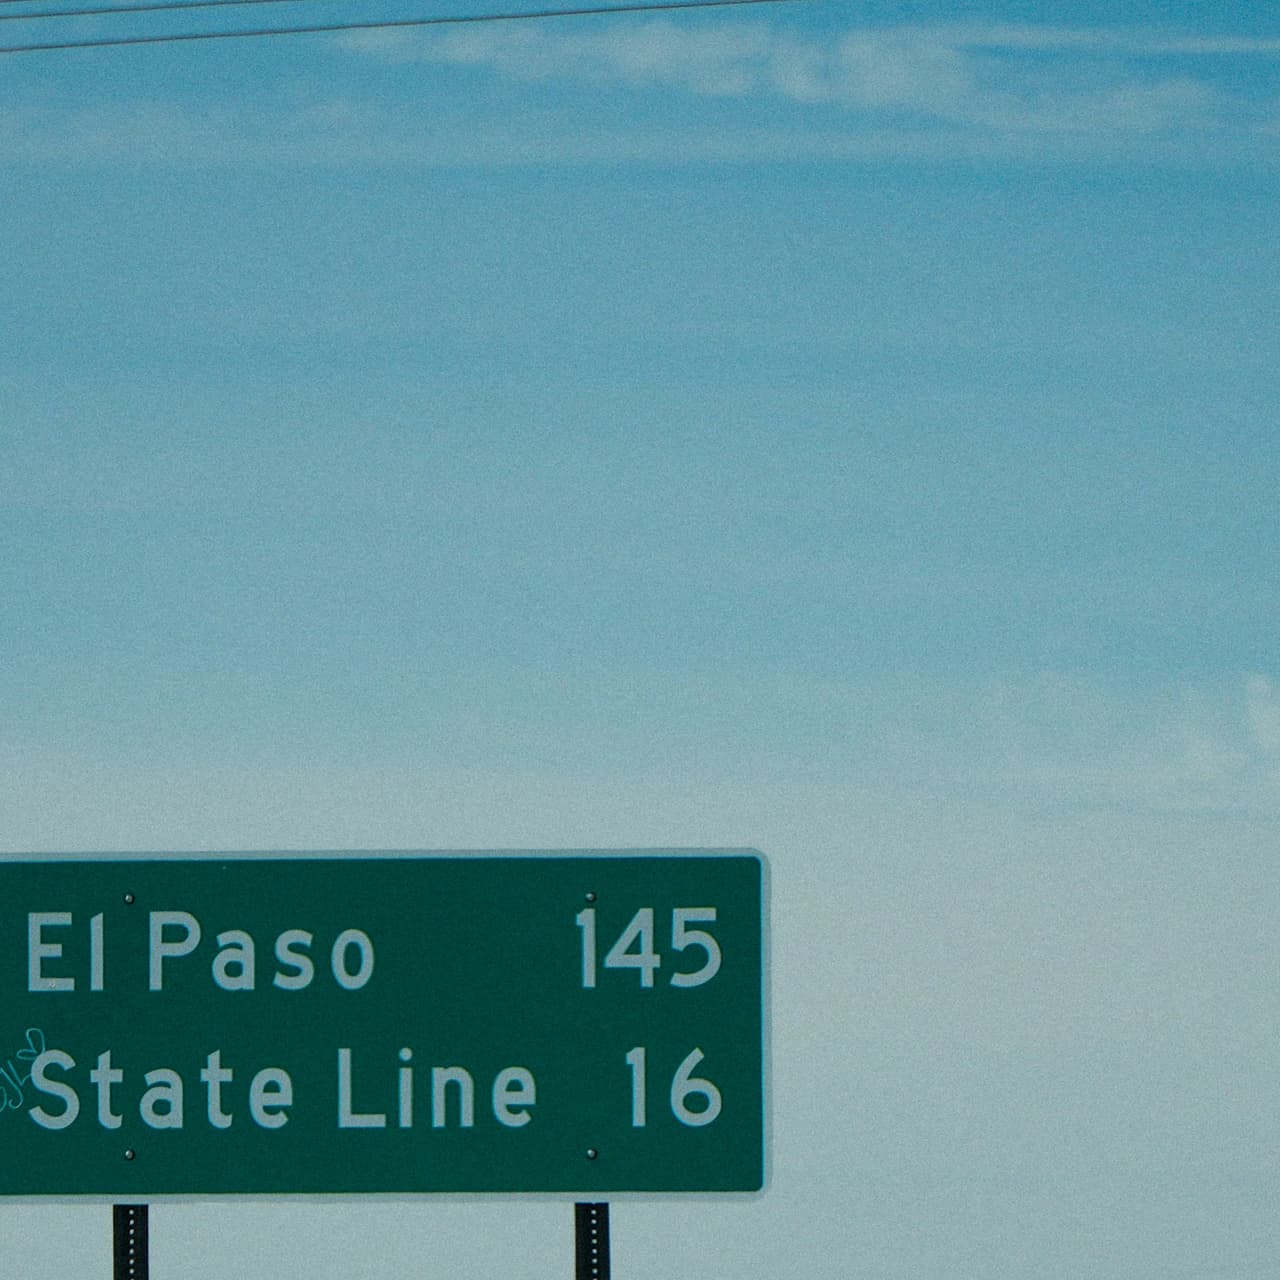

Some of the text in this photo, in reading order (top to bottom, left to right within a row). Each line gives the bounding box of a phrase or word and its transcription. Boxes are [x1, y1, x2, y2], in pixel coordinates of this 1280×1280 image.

[29, 908, 721, 990] El Paso 145
[30, 1048, 721, 1128] State Line 16
